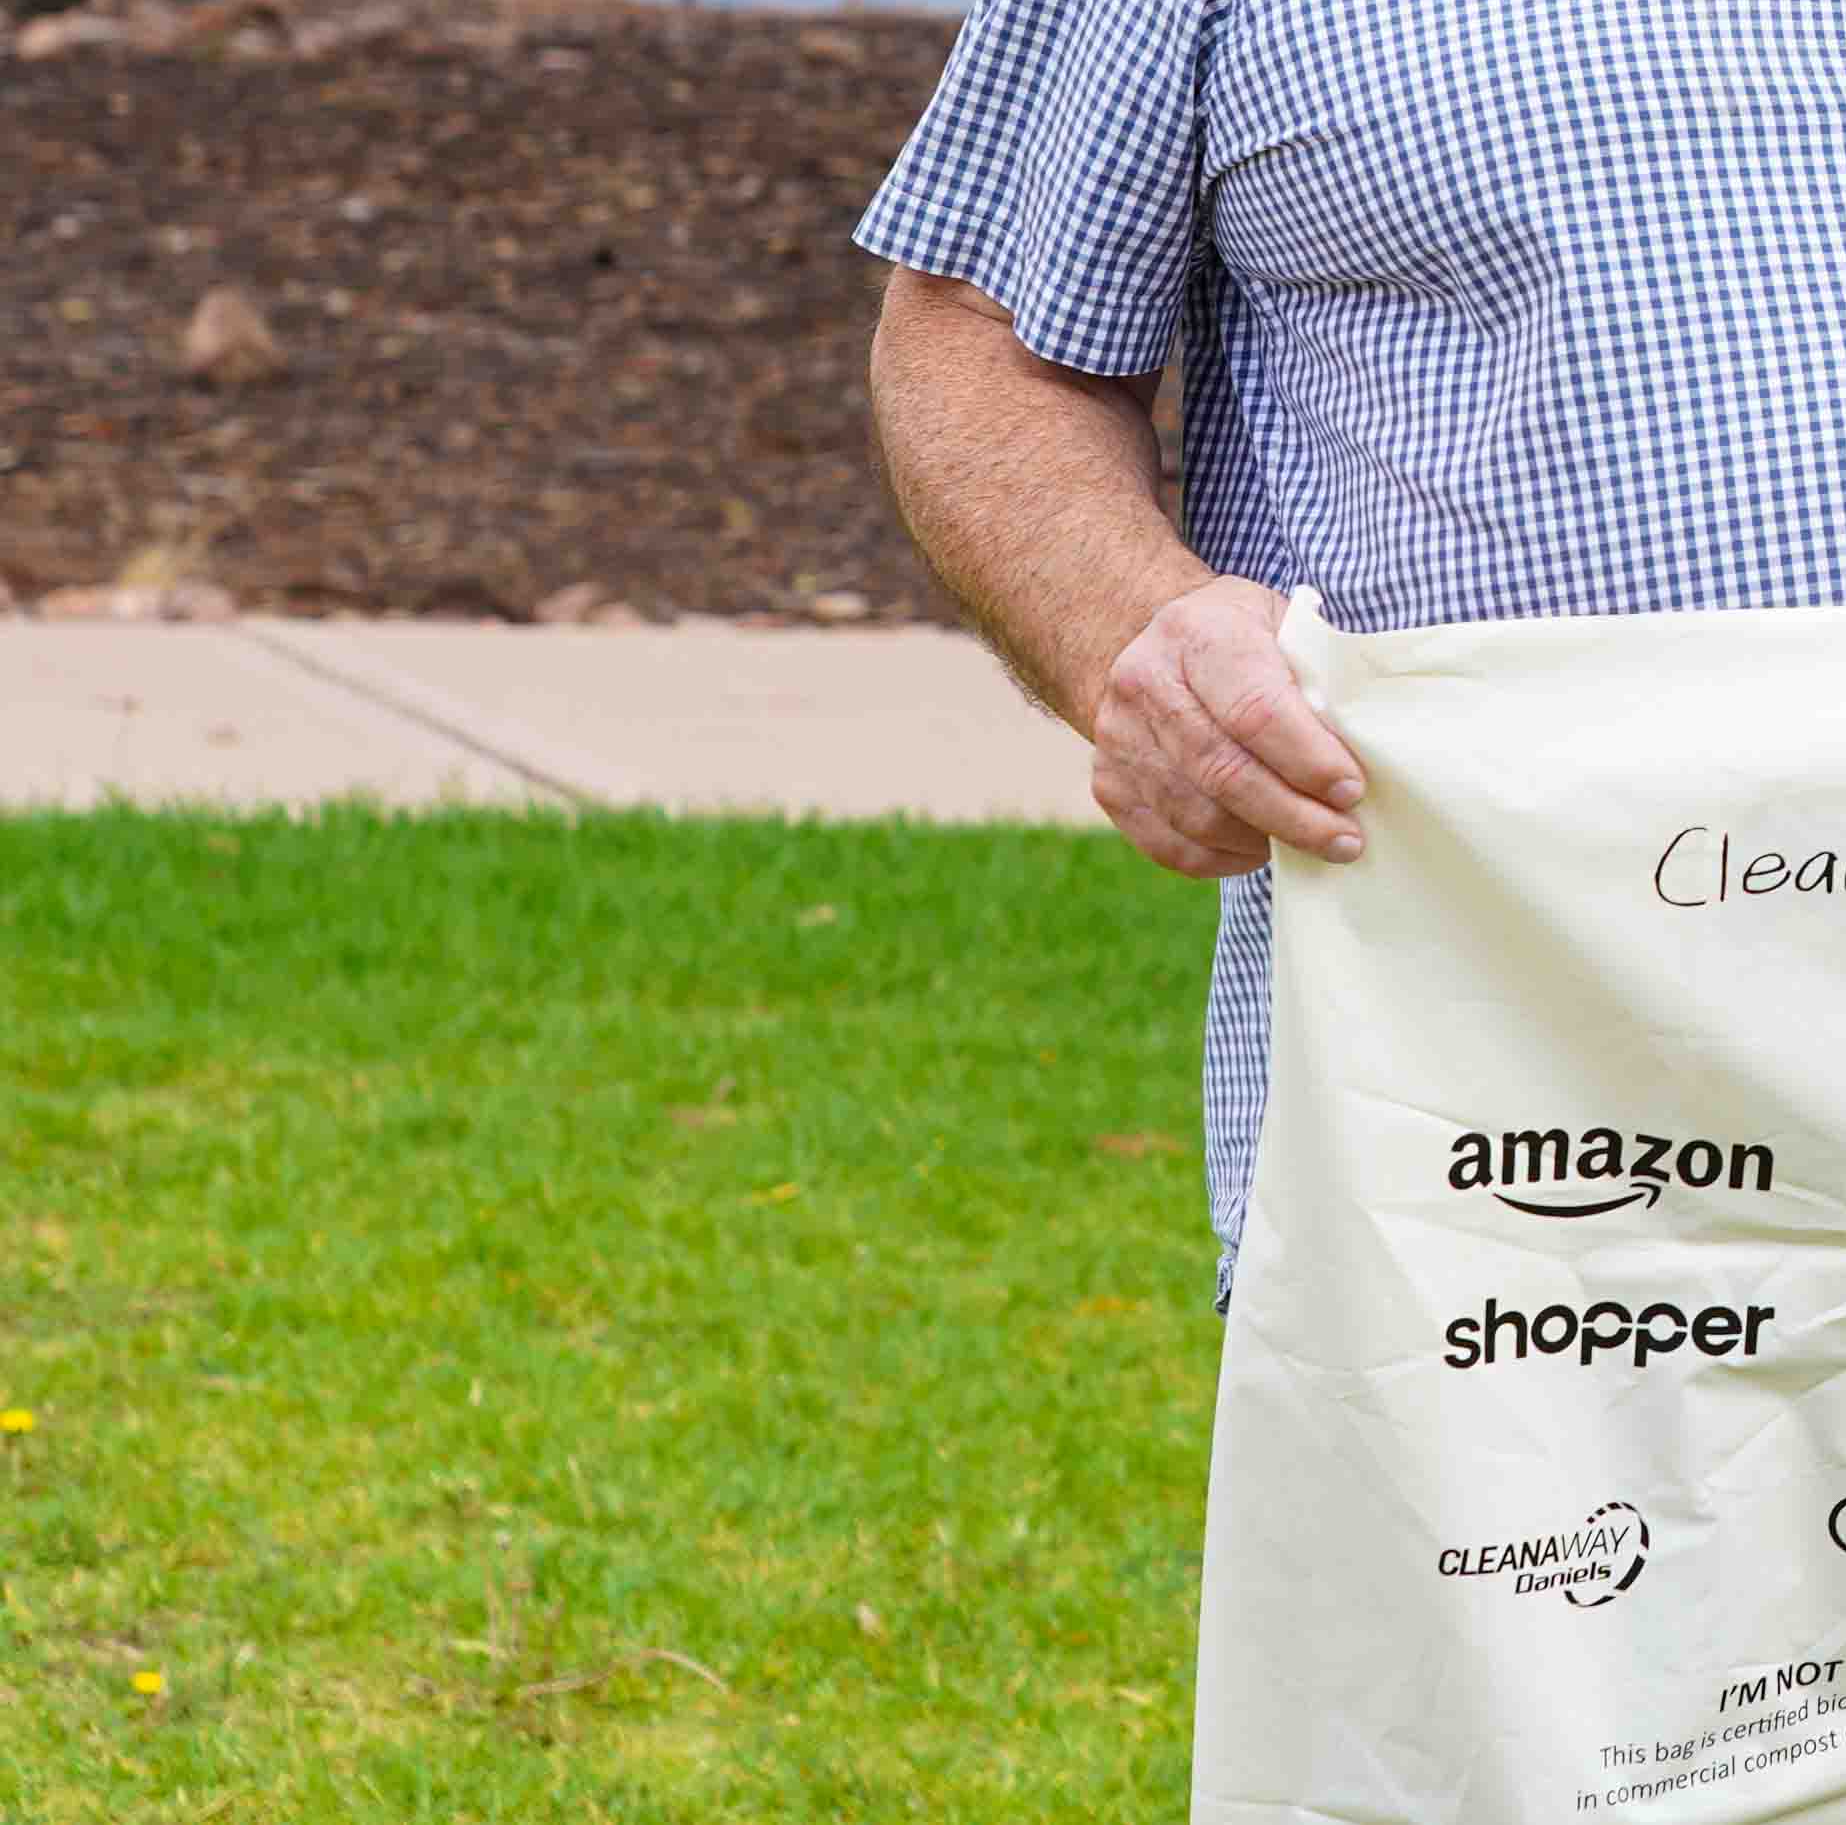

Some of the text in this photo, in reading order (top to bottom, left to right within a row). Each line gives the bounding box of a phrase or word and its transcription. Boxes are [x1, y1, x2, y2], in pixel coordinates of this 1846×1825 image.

[1448, 1127, 1774, 1191] amazon
[1444, 1298, 1775, 1369] shopper
[1437, 1525, 1630, 1576] CLEANAWAY
[1515, 1561, 1612, 1594] Daniels
[1718, 1677, 1767, 1712] I'M
[1776, 1660, 1843, 1695] NOT
[1599, 1745, 1647, 1770] This
[1655, 1736, 1696, 1762] bag
[1699, 1730, 1715, 1750] is
[1721, 1705, 1809, 1743] certified
[1576, 1789, 1598, 1812] in
[1606, 1756, 1737, 1807] commercial
[1743, 1733, 1839, 1775] compost
